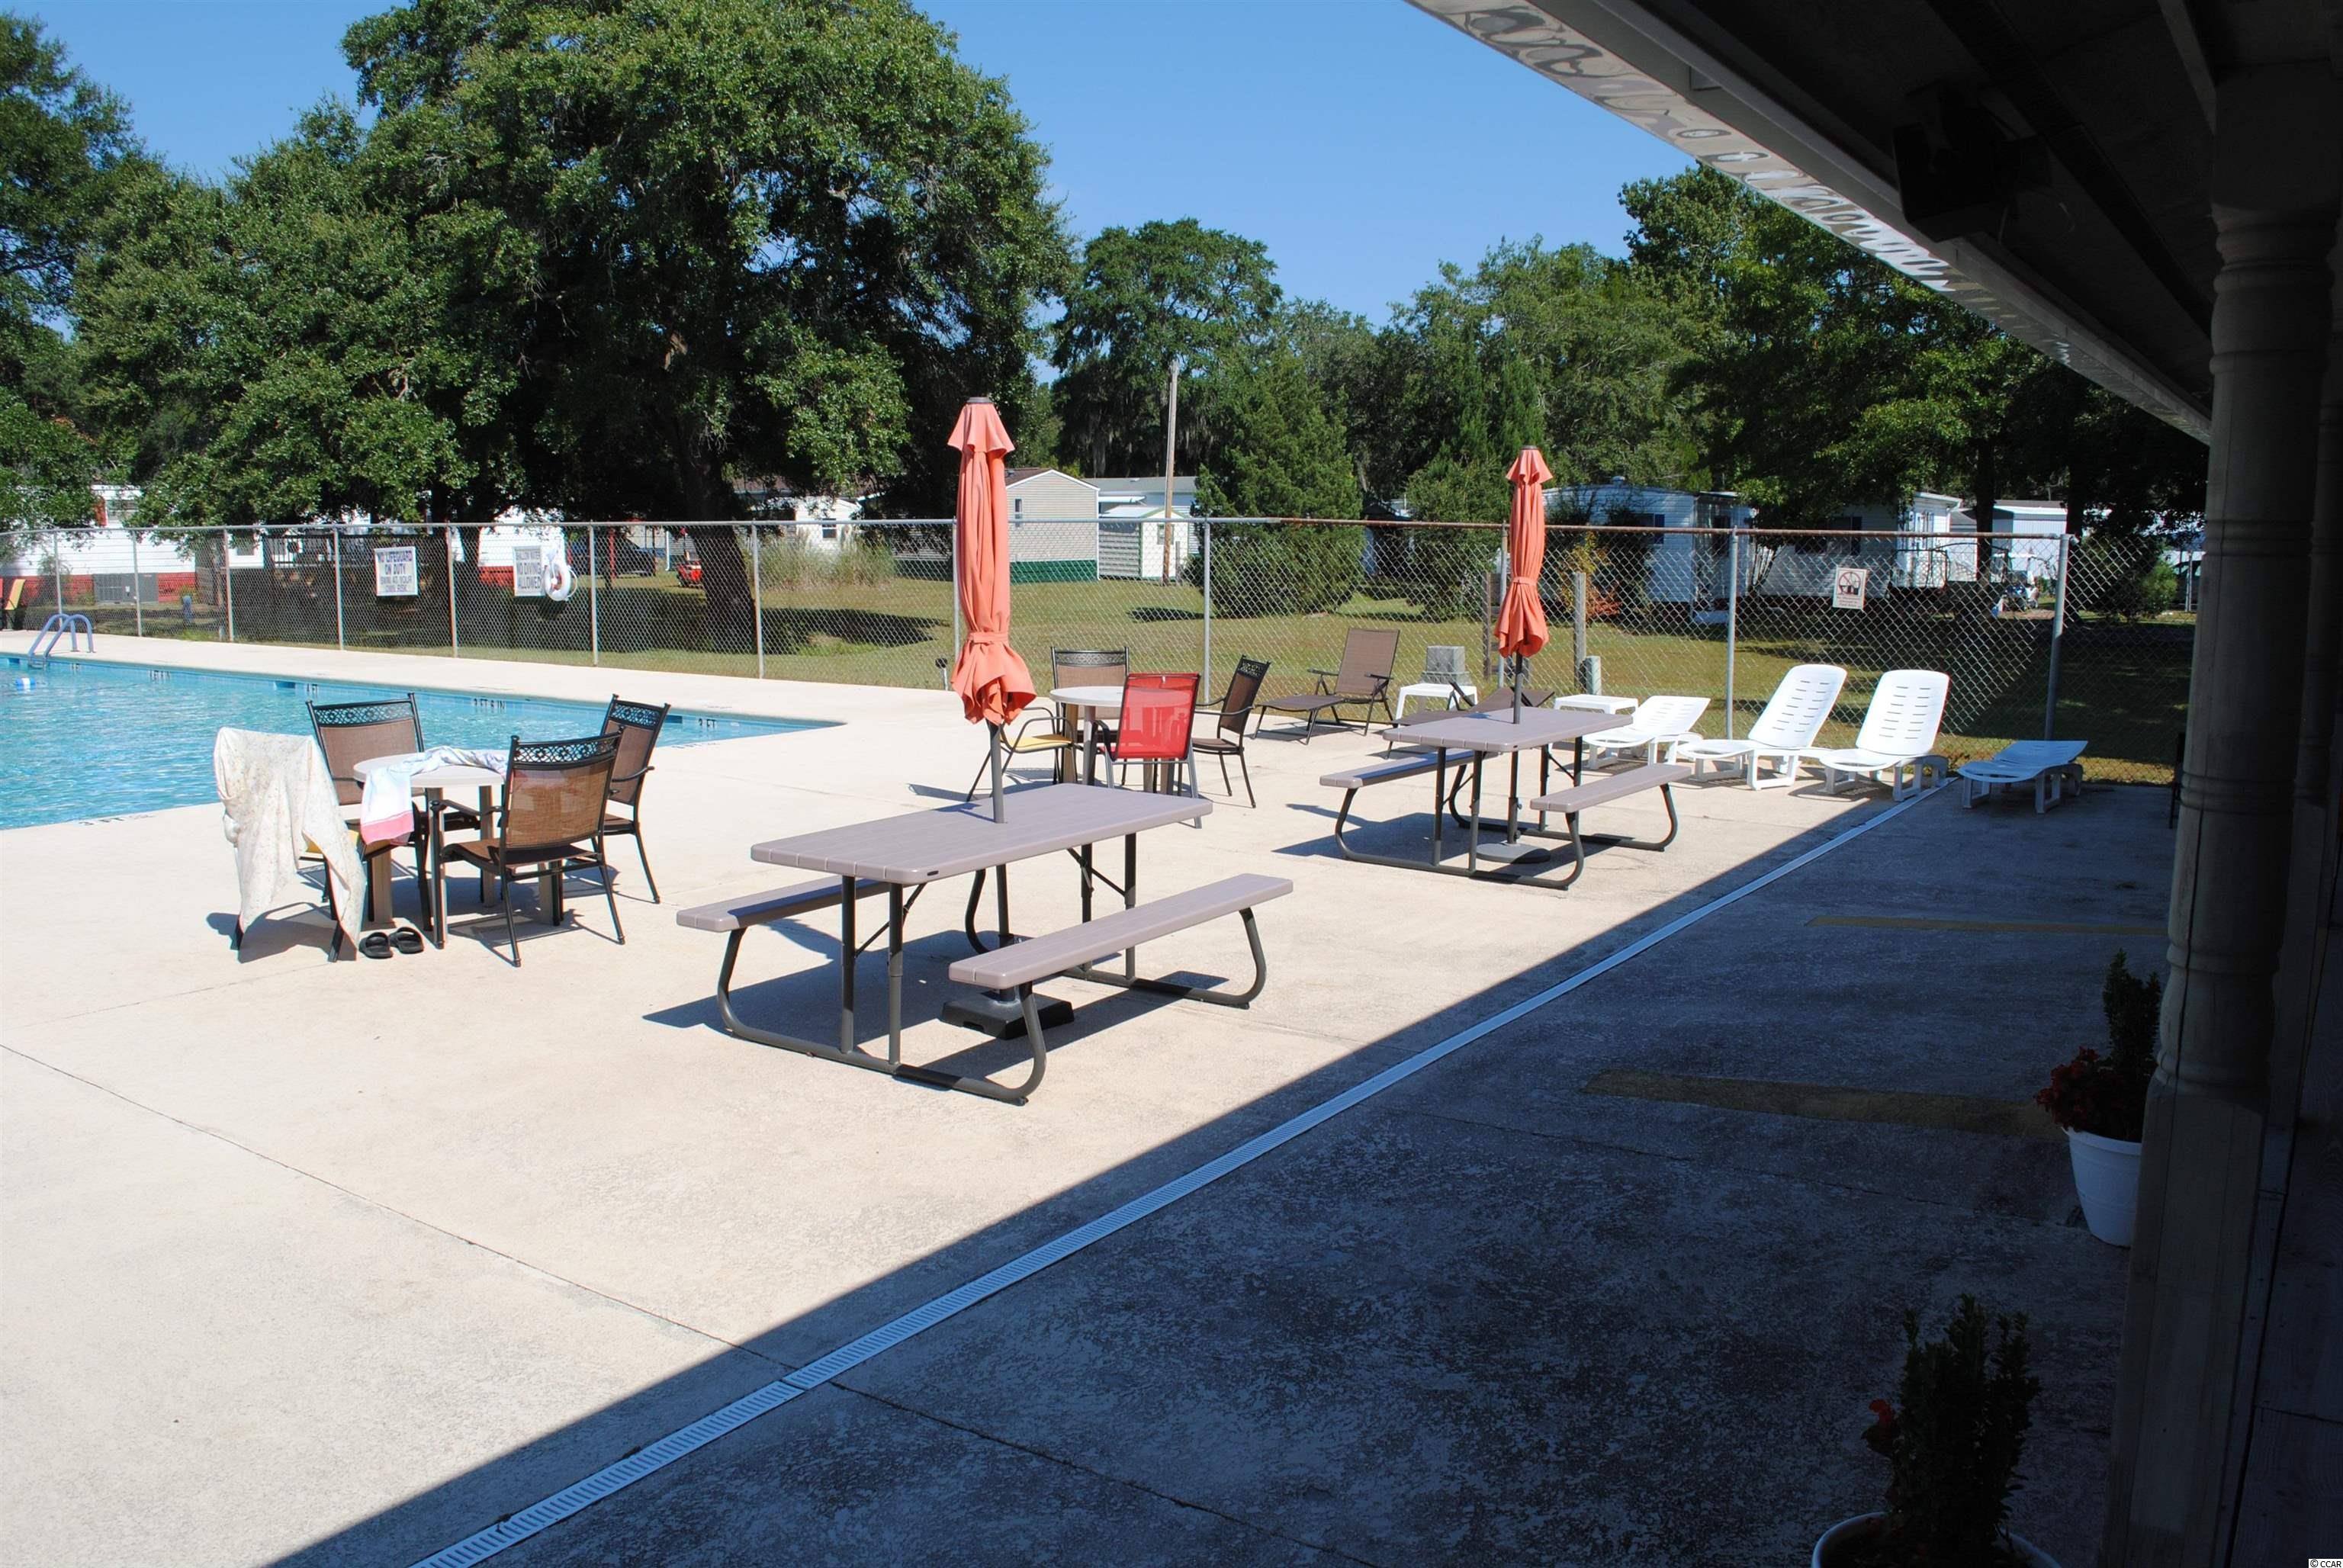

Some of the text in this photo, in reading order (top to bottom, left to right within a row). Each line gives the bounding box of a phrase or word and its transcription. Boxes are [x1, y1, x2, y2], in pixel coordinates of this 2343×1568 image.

[386, 550, 412, 562] LIFEGUARD
[385, 563, 406, 574] ON DUTY
[524, 562, 542, 575] DIVING
[517, 576, 541, 589] ALLOWED
